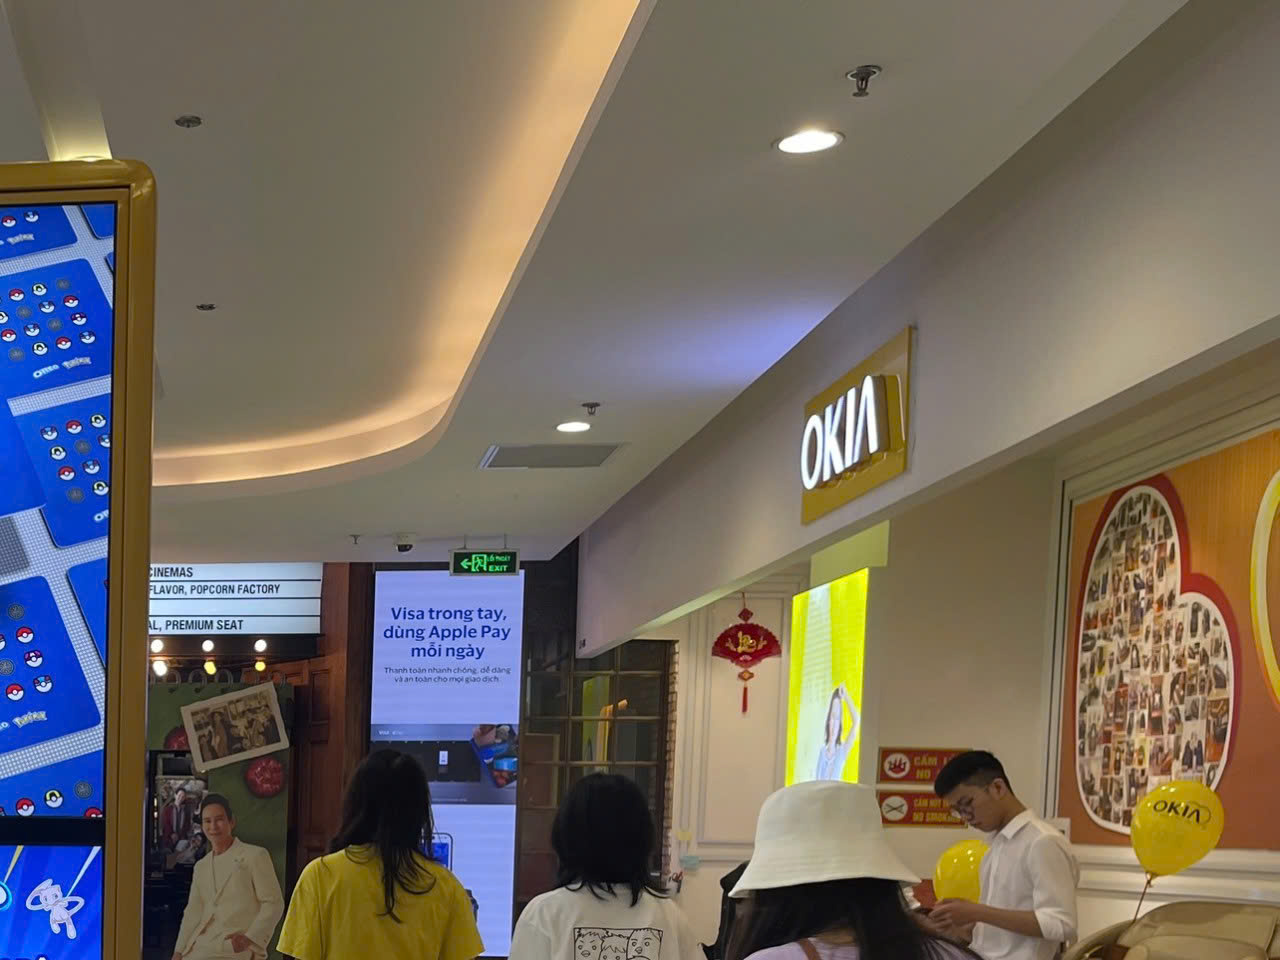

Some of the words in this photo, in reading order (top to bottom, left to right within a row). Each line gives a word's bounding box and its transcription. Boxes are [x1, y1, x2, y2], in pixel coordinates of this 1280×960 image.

[800, 374, 880, 491] OKIA
[488, 564, 509, 572] EXIT
[190, 584, 235, 595] POPCORN
[237, 583, 281, 594] FACTORY
[391, 606, 425, 620] Visa
[428, 607, 474, 622] trong
[477, 607, 507, 621] tay,
[165, 619, 214, 631] PREMIUM
[216, 619, 244, 630] SEAT
[383, 625, 425, 641] dùng
[428, 625, 477, 641] Apple
[481, 624, 511, 641] Pay
[410, 641, 442, 658] mỗi
[445, 643, 485, 660] ngày
[427, 667, 453, 675] nhanh
[465, 676, 482, 684] giao
[915, 769, 931, 779] NO
[1153, 799, 1201, 825] OKIA
